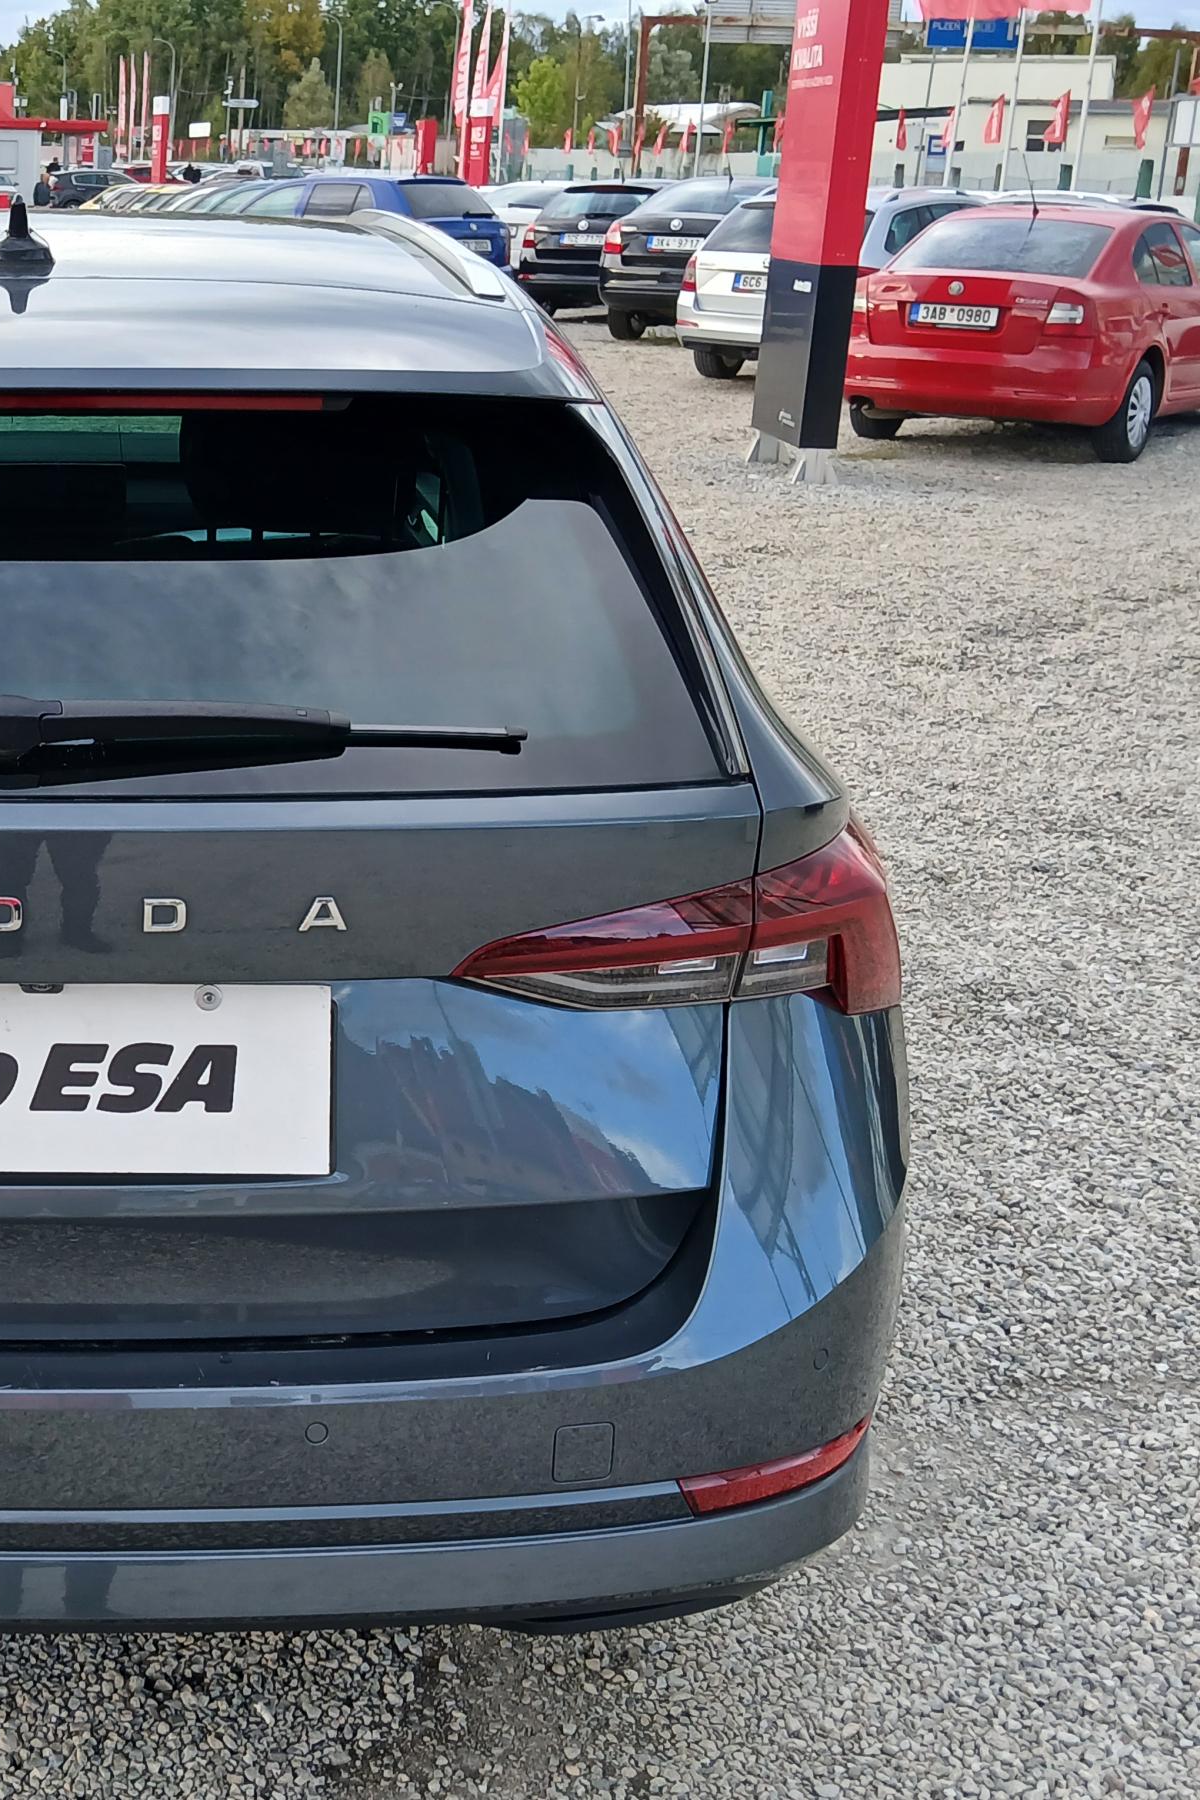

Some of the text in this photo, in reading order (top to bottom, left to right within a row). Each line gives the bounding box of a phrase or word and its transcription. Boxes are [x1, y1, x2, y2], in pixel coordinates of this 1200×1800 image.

[742, 275, 762, 288] 6C6
[921, 306, 991, 323] 3AB 0980
[29, 1042, 238, 1113] ESA
